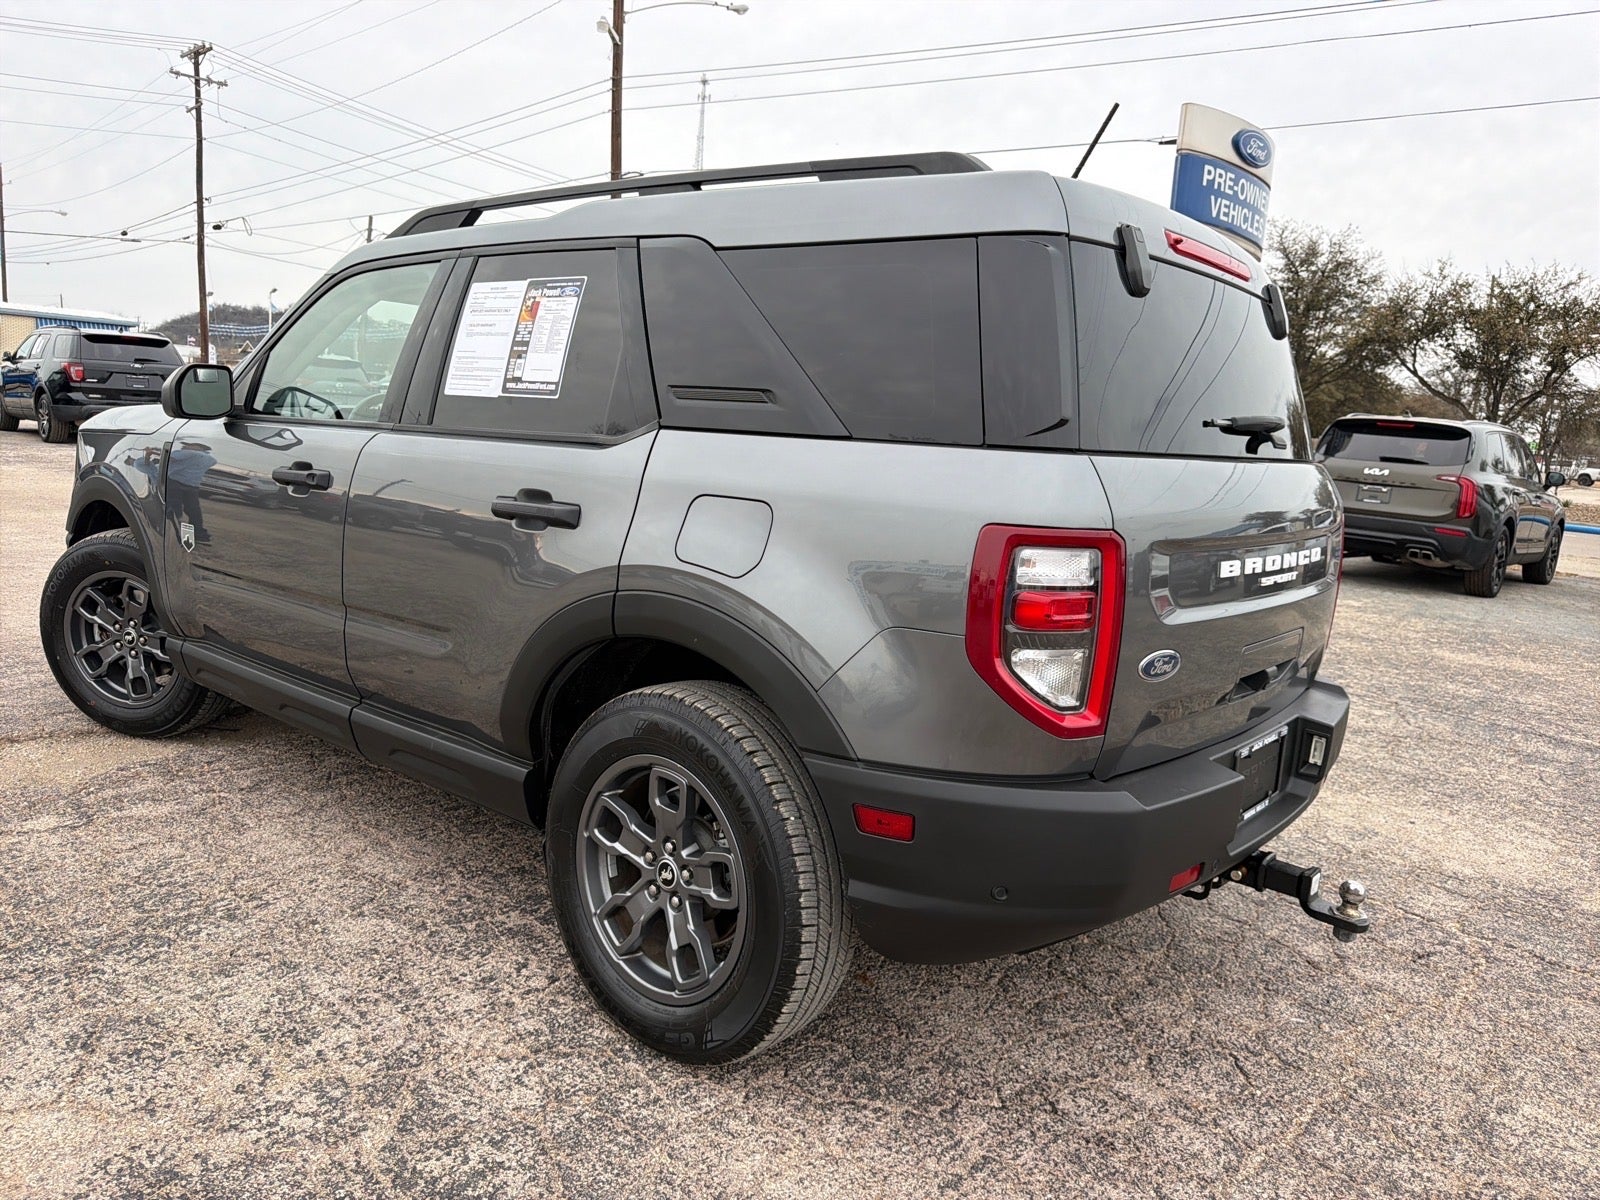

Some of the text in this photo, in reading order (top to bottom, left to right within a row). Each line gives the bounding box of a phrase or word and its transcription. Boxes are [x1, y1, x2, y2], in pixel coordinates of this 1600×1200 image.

[1246, 137, 1268, 161] Ford
[1202, 164, 1269, 214] PRE-OWNE
[1210, 195, 1264, 238] VEHICLES
[1220, 547, 1322, 578] BRONCO
[1259, 571, 1298, 587] SPORT
[1150, 656, 1175, 675] Ford
[676, 727, 759, 832] YOKOHAMA
